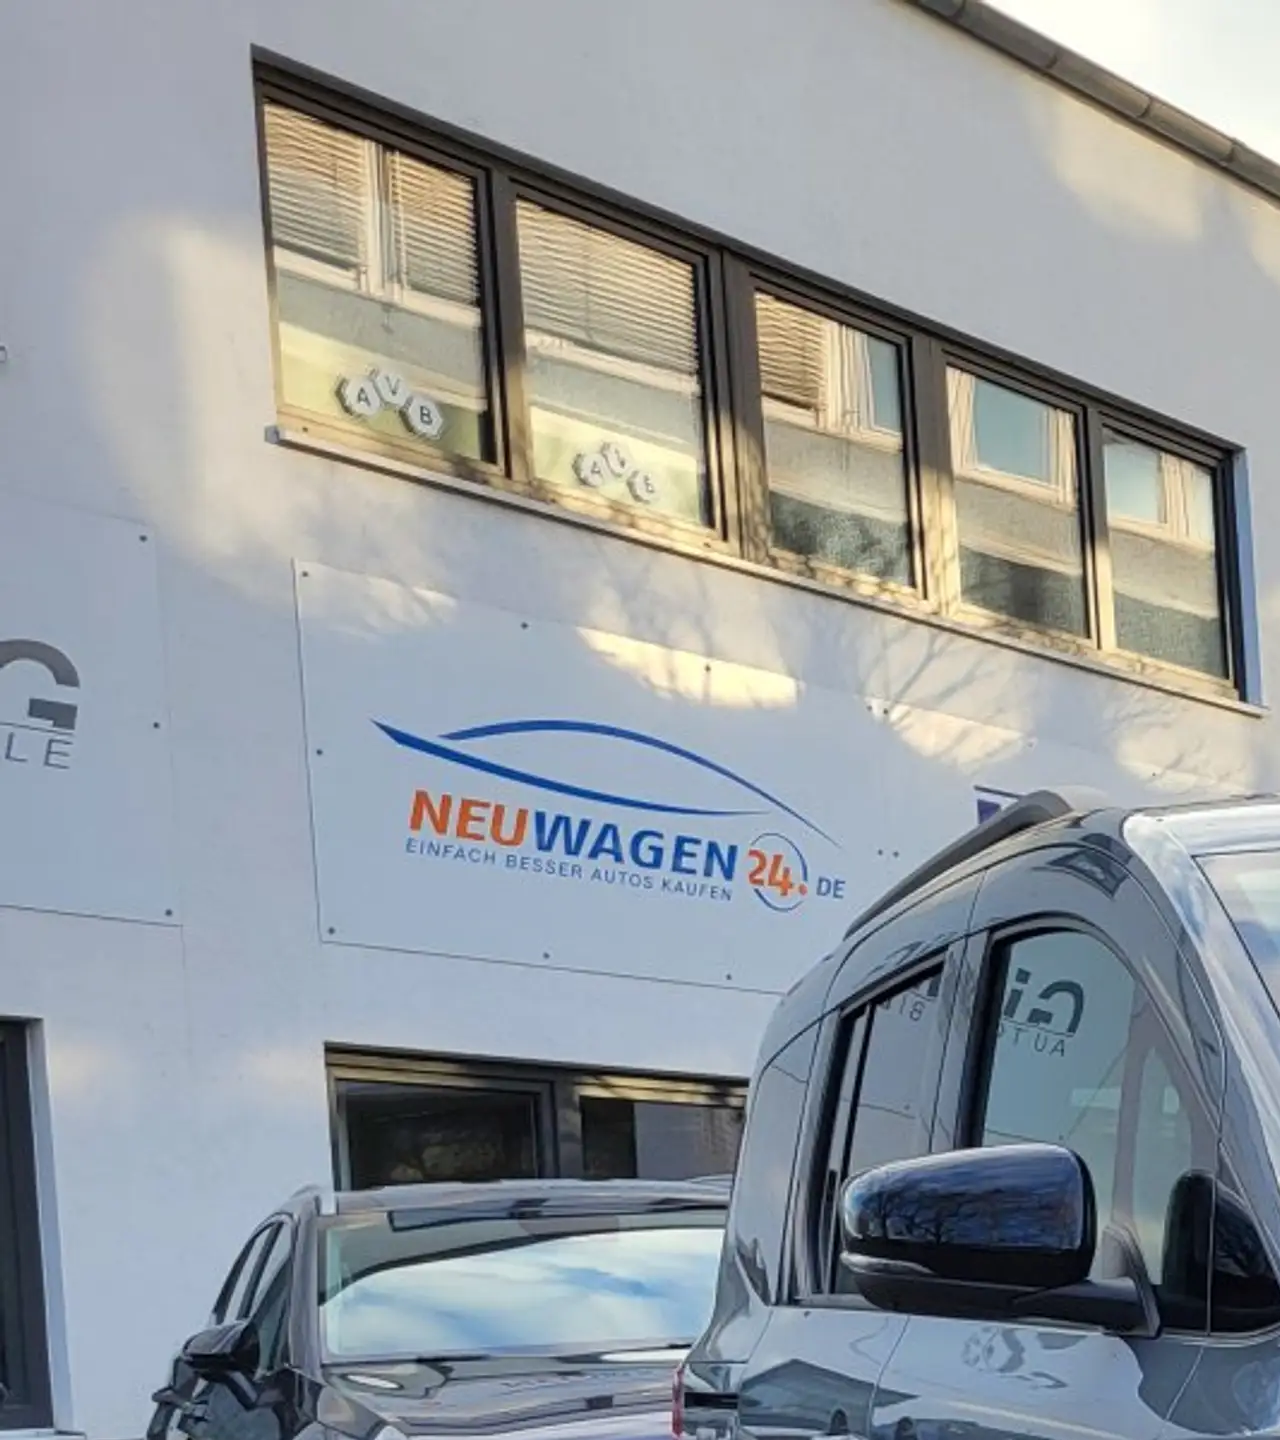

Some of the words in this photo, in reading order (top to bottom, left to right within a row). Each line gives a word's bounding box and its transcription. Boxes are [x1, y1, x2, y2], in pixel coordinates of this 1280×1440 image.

[406, 837, 496, 865] EINFACH
[505, 854, 583, 880] BESSER
[590, 868, 654, 890] AUTOS
[661, 874, 734, 901] KAUFEN
